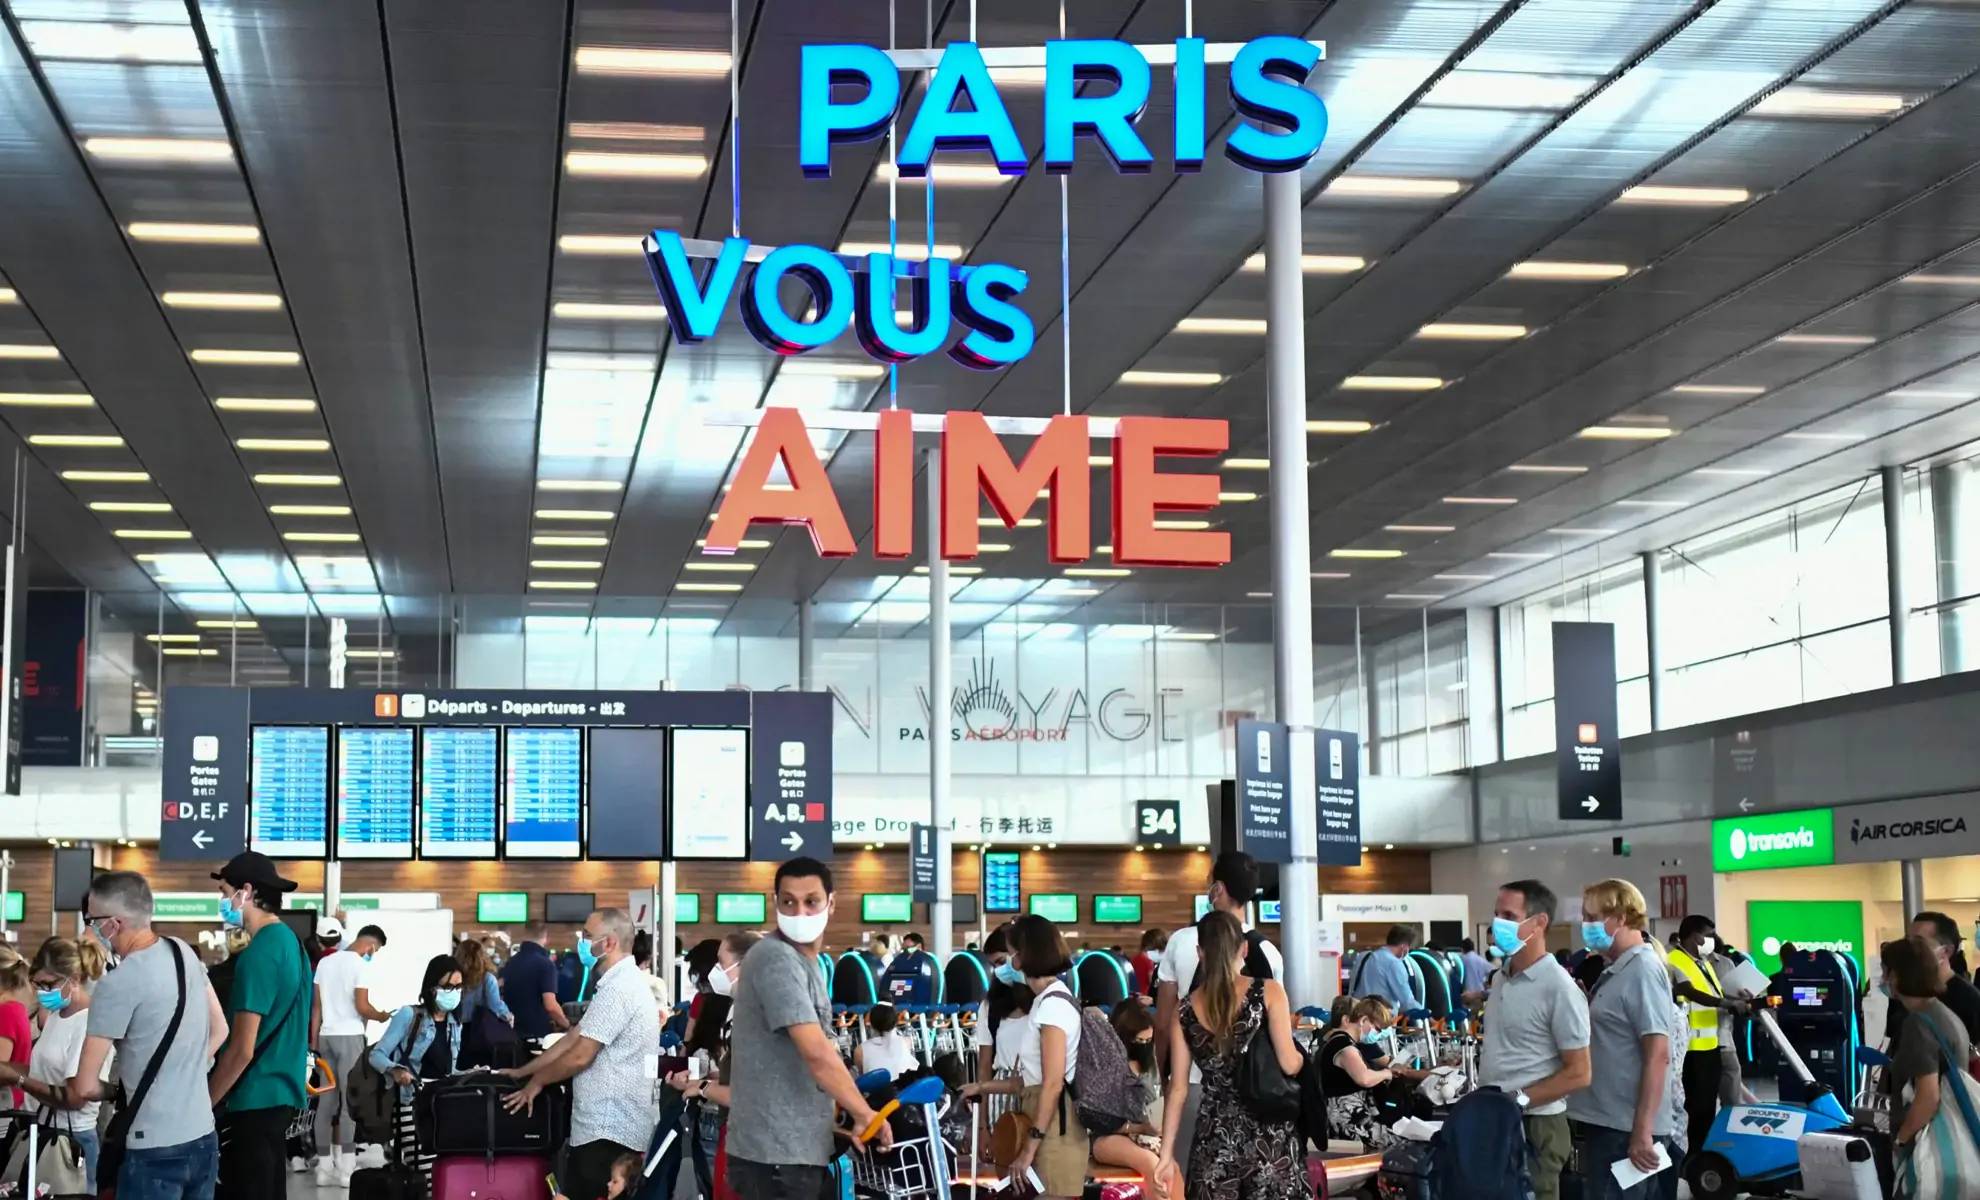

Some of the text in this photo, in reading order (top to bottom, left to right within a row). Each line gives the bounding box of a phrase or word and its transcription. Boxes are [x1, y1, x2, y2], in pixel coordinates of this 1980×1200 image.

[800, 35, 1329, 178] PARIS
[641, 229, 1035, 370] VOUS
[702, 406, 1231, 567] AIME
[428, 699, 487, 716] Départs
[502, 701, 586, 716] Departures
[899, 727, 961, 741] PAS
[190, 765, 220, 775] Portes
[191, 776, 217, 786] Gates
[780, 779, 805, 788] Gates
[980, 816, 1053, 834] 行李托运
[1141, 808, 1177, 835] 34
[1860, 817, 1967, 841] AIR CORSICA
[1748, 825, 1814, 851] transavia
